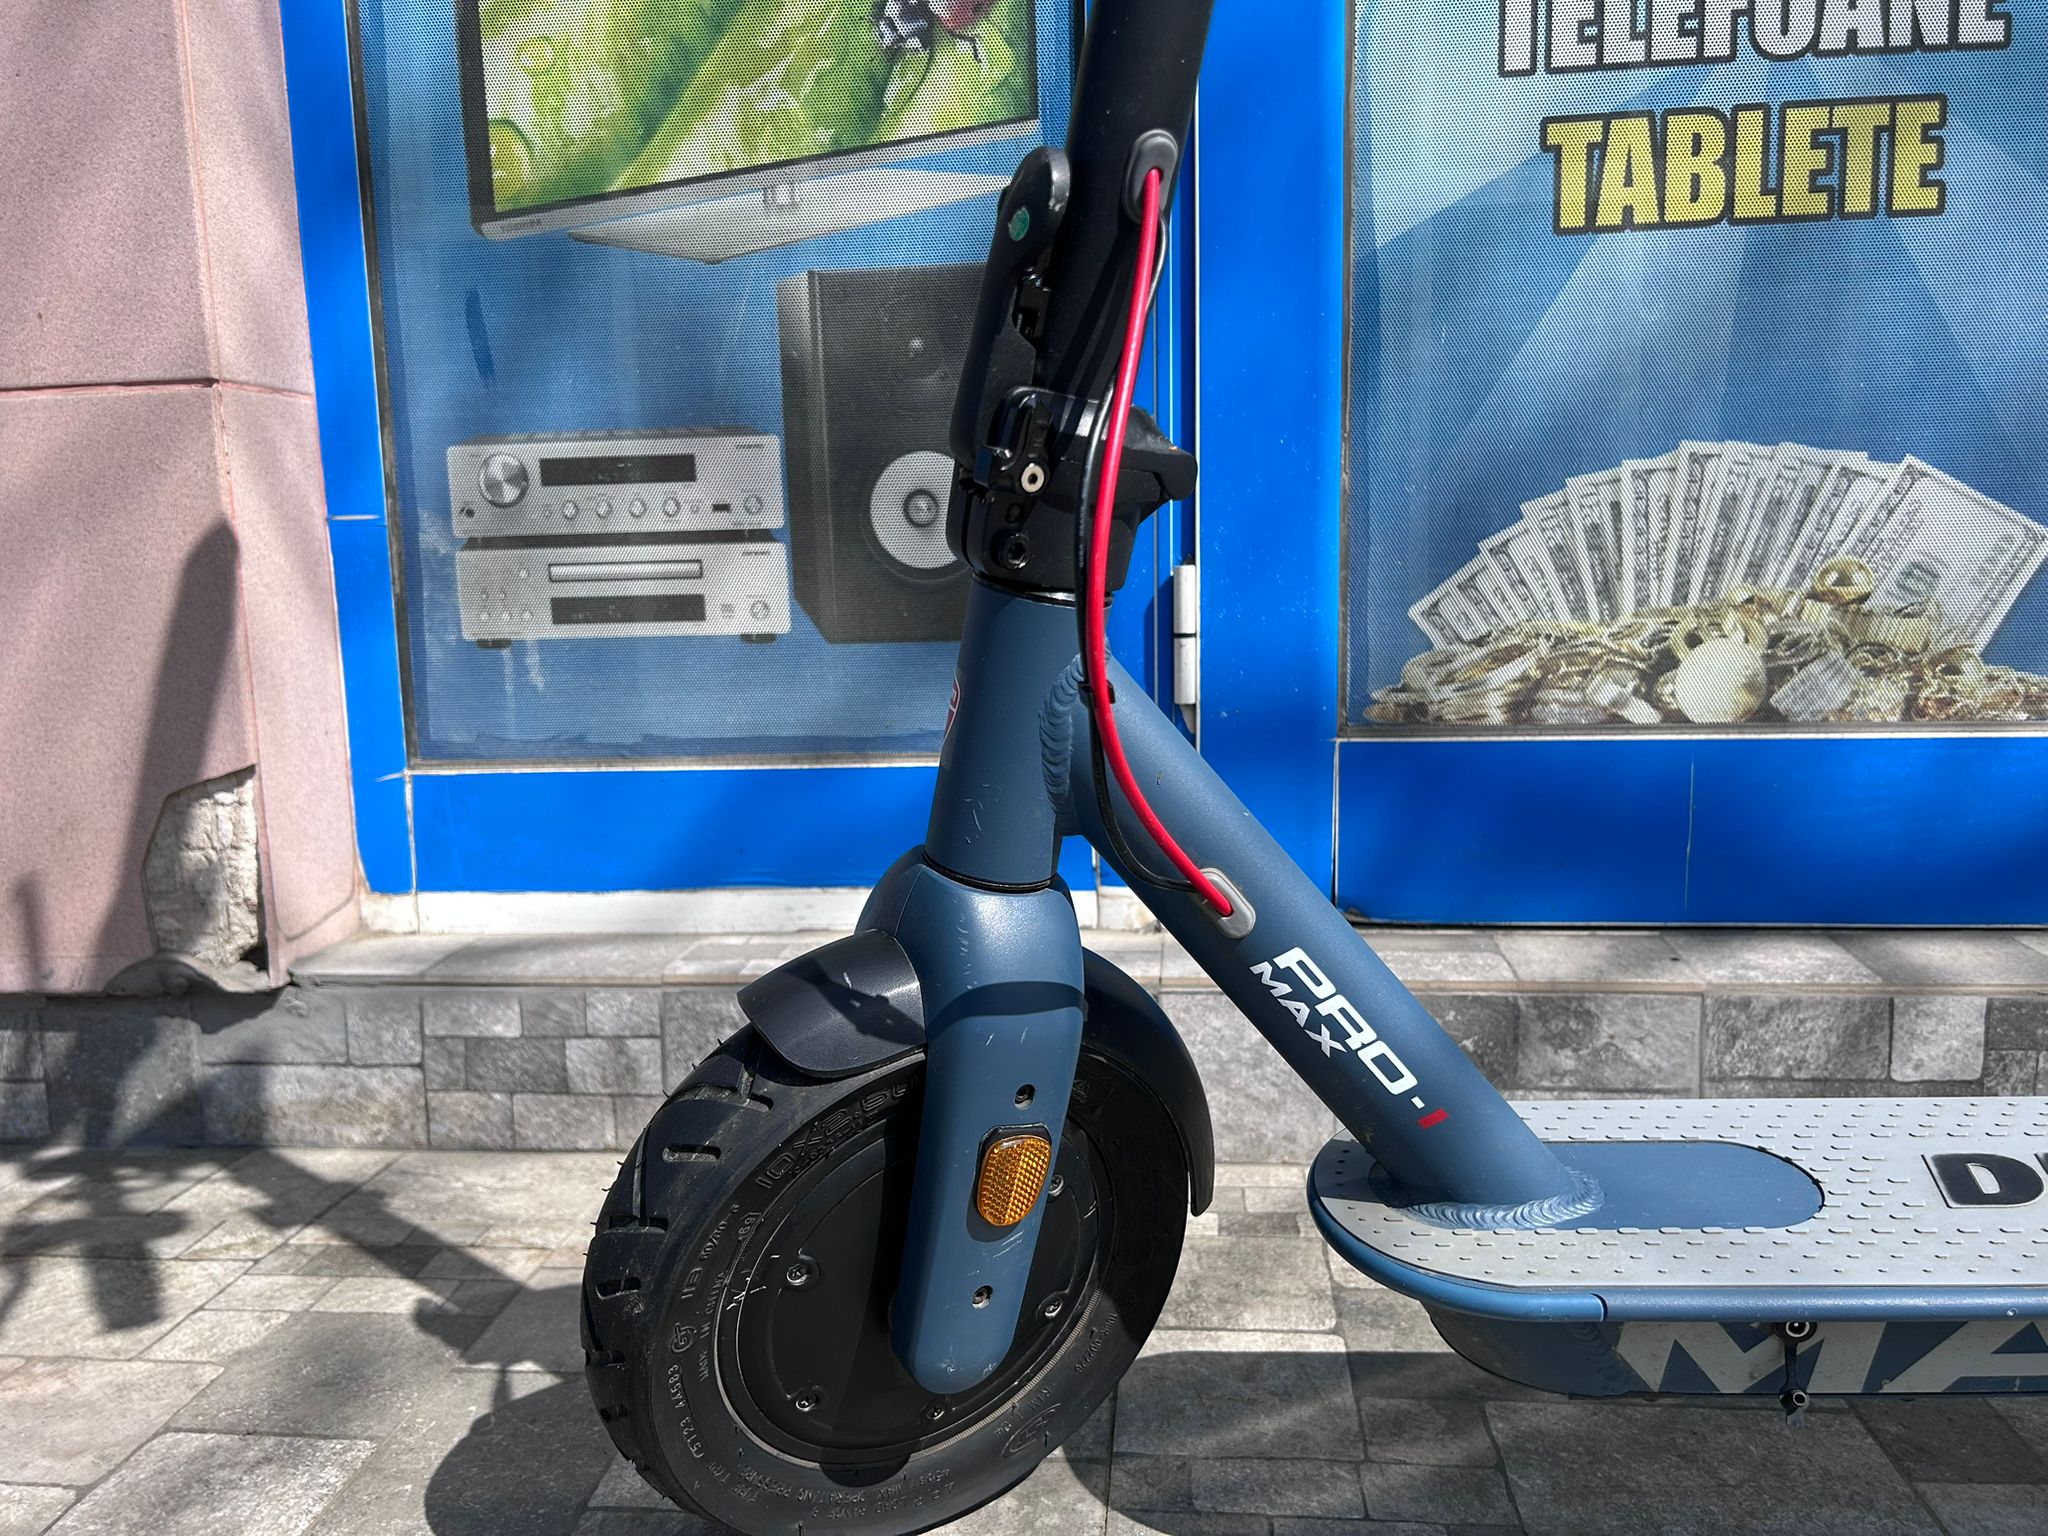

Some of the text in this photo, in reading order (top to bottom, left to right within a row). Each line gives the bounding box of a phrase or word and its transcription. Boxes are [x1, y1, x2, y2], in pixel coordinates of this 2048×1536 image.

[1541, 95, 1946, 234] TABLETE
[1250, 961, 1347, 1058] MAX
[1921, 1151, 2048, 1209] D
